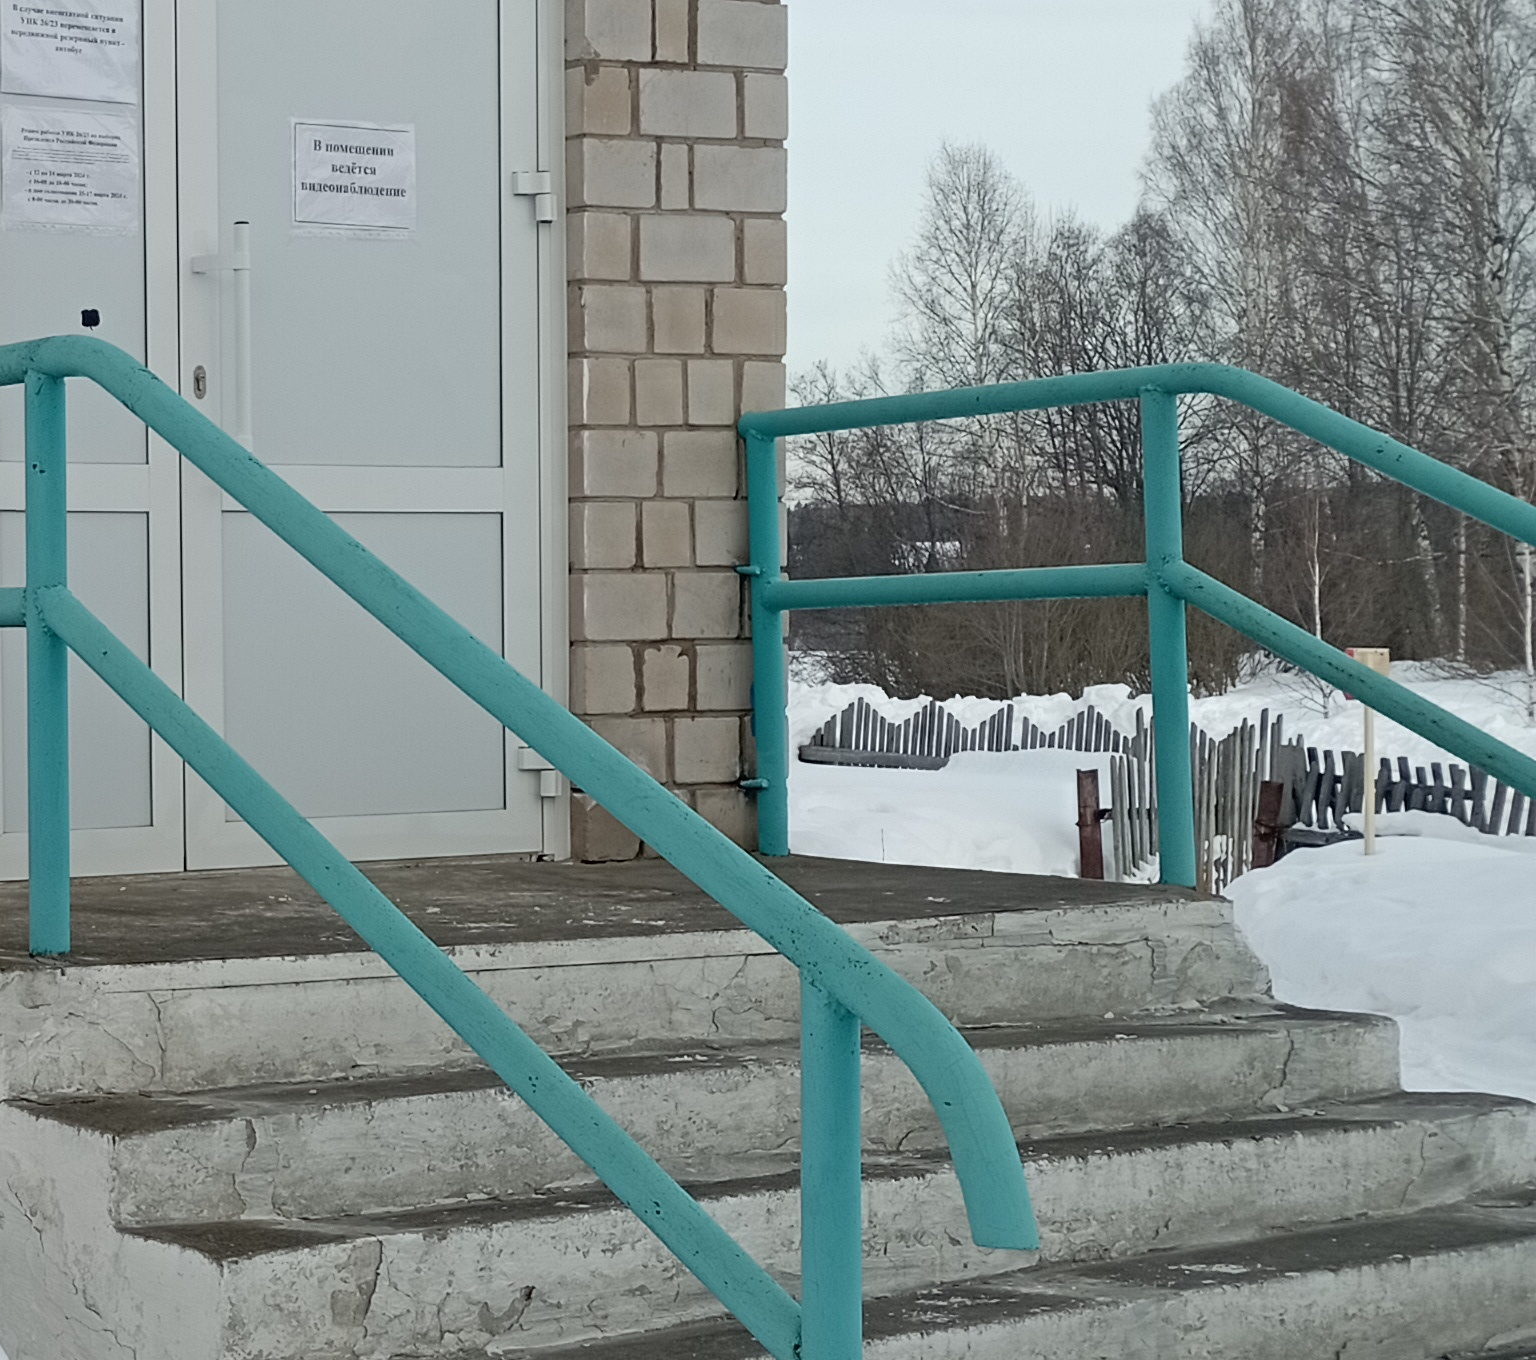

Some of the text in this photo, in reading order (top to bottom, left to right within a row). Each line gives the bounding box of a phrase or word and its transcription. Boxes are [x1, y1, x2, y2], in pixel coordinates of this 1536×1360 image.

[313, 139, 322, 152] В
[331, 162, 377, 176] ведётся
[300, 181, 407, 198] видеонаблюдение
